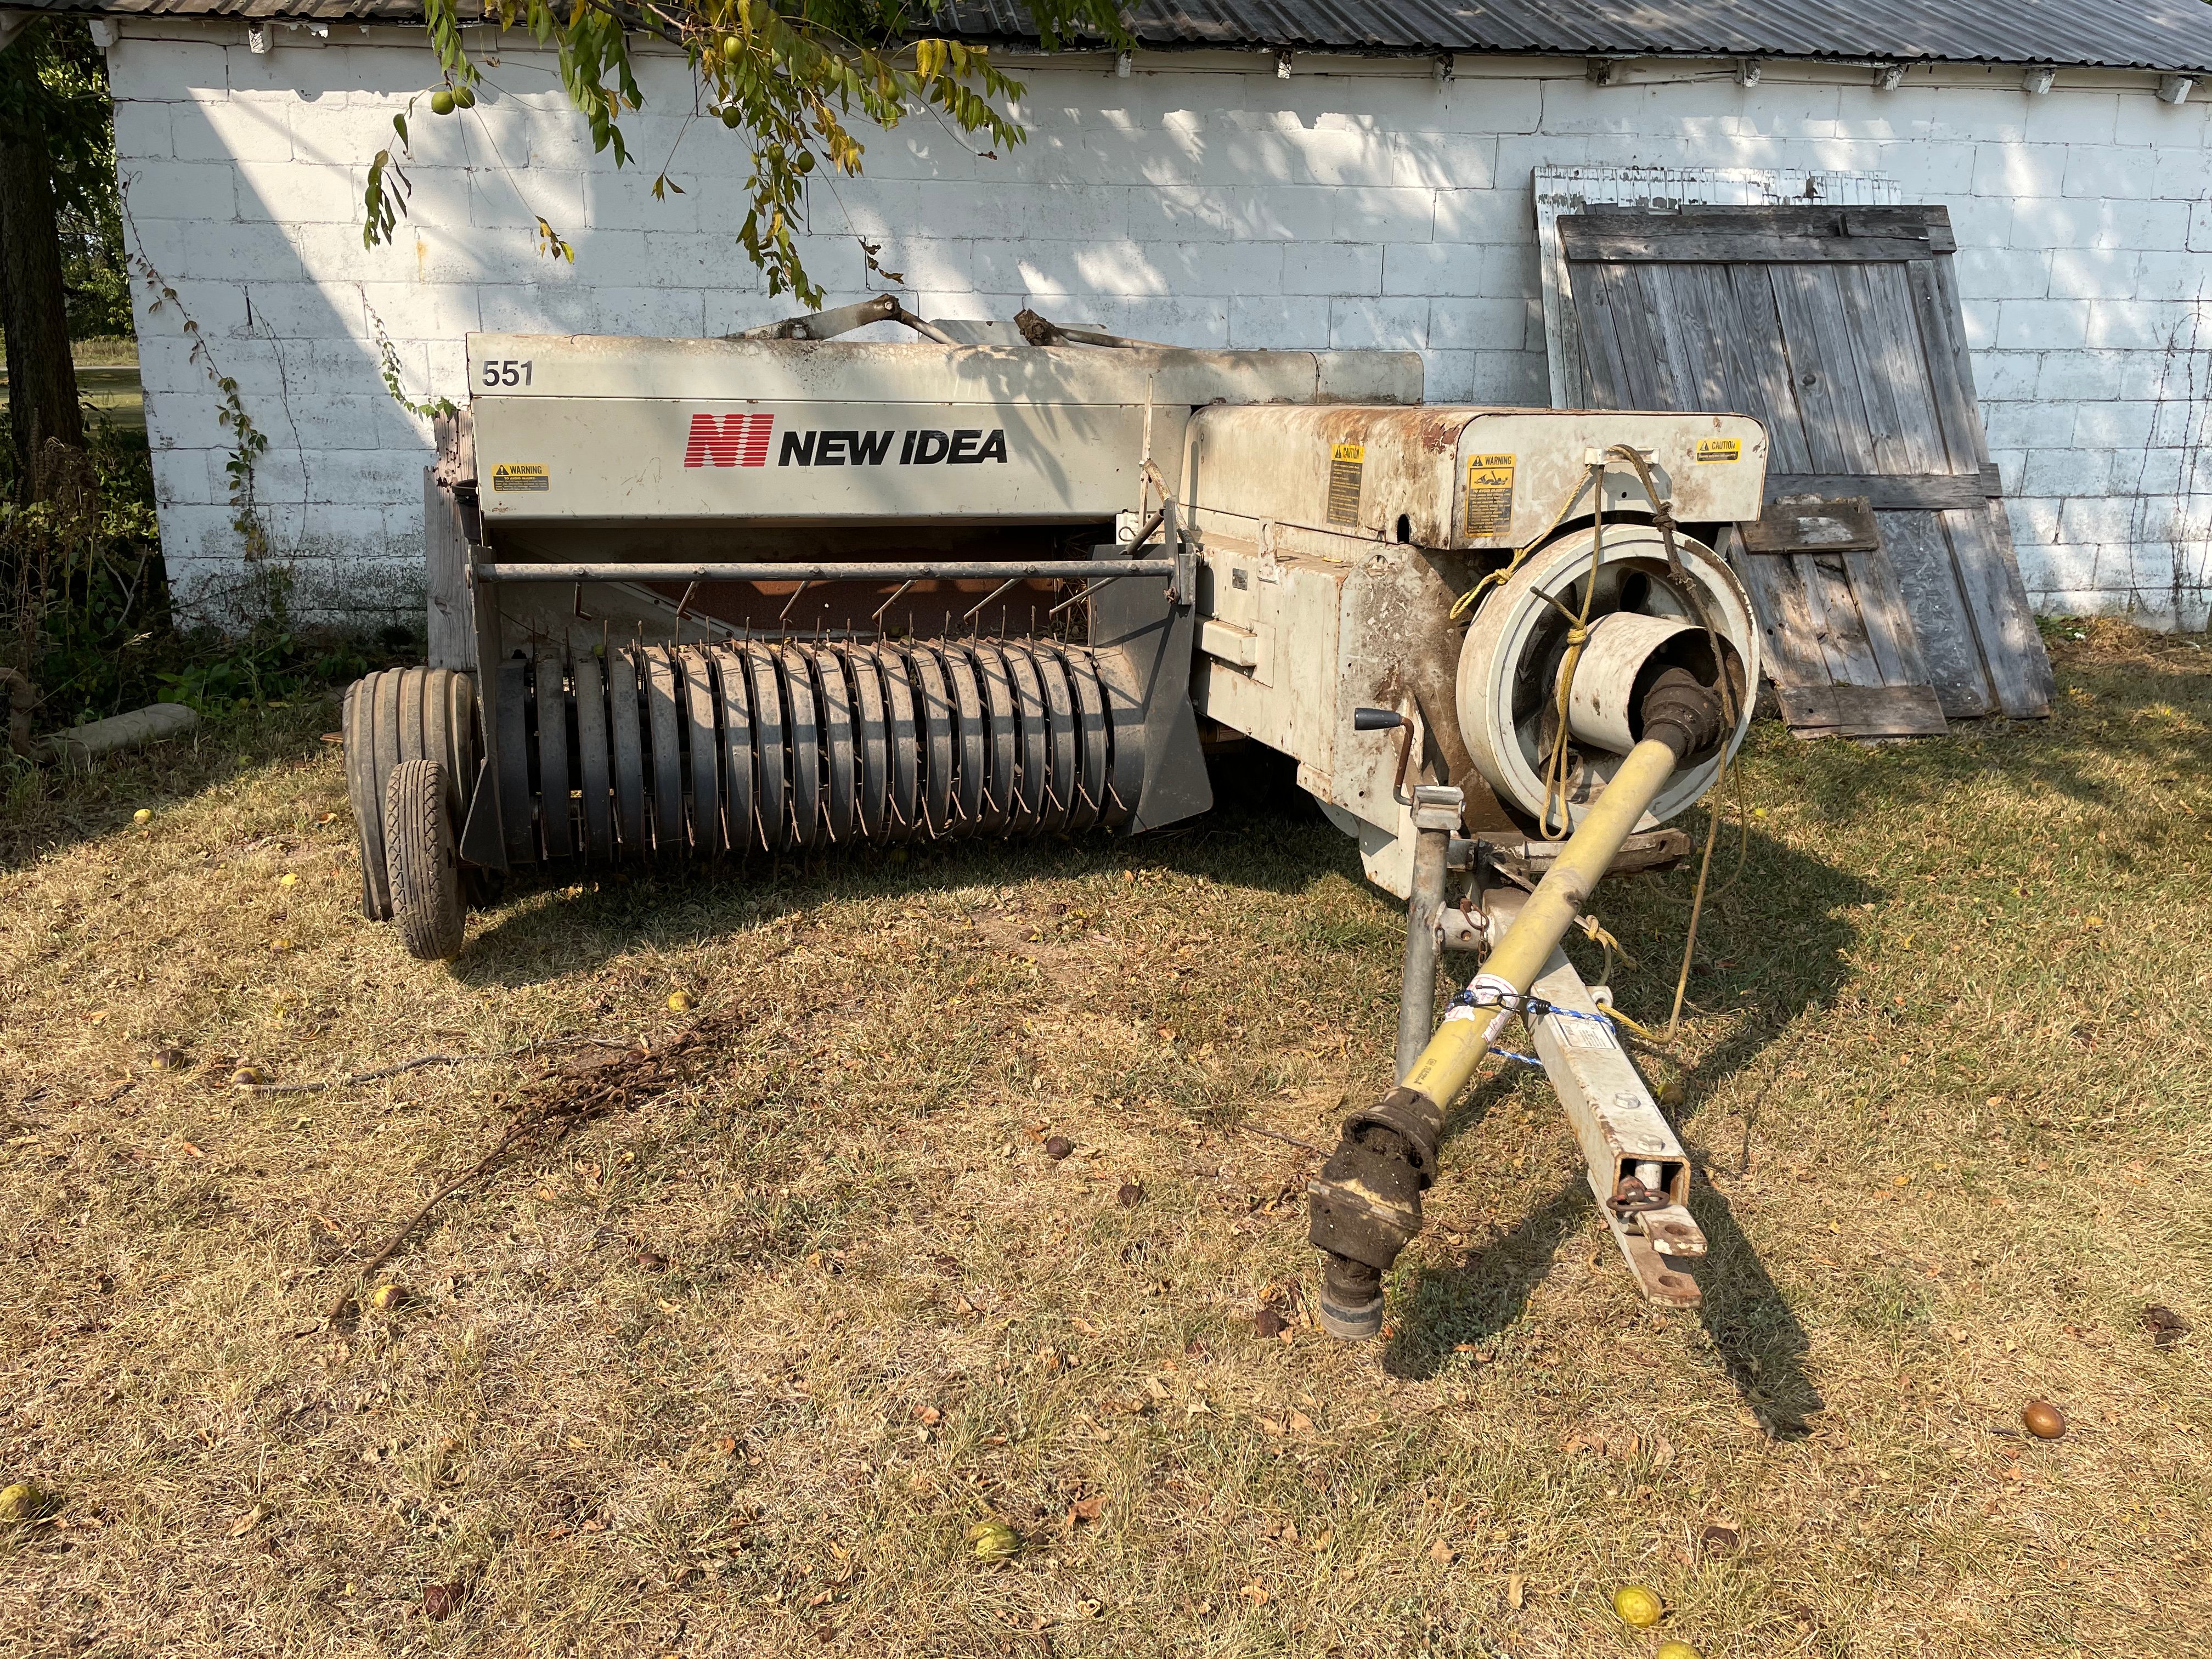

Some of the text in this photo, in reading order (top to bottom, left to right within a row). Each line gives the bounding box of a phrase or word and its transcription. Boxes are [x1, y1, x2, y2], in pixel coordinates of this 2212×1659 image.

[482, 360, 532, 386] 551
[778, 430, 895, 466] NEW
[899, 429, 1008, 465] IDEA
[1485, 456, 1512, 465] WARNING
[509, 465, 542, 474] WARNING
